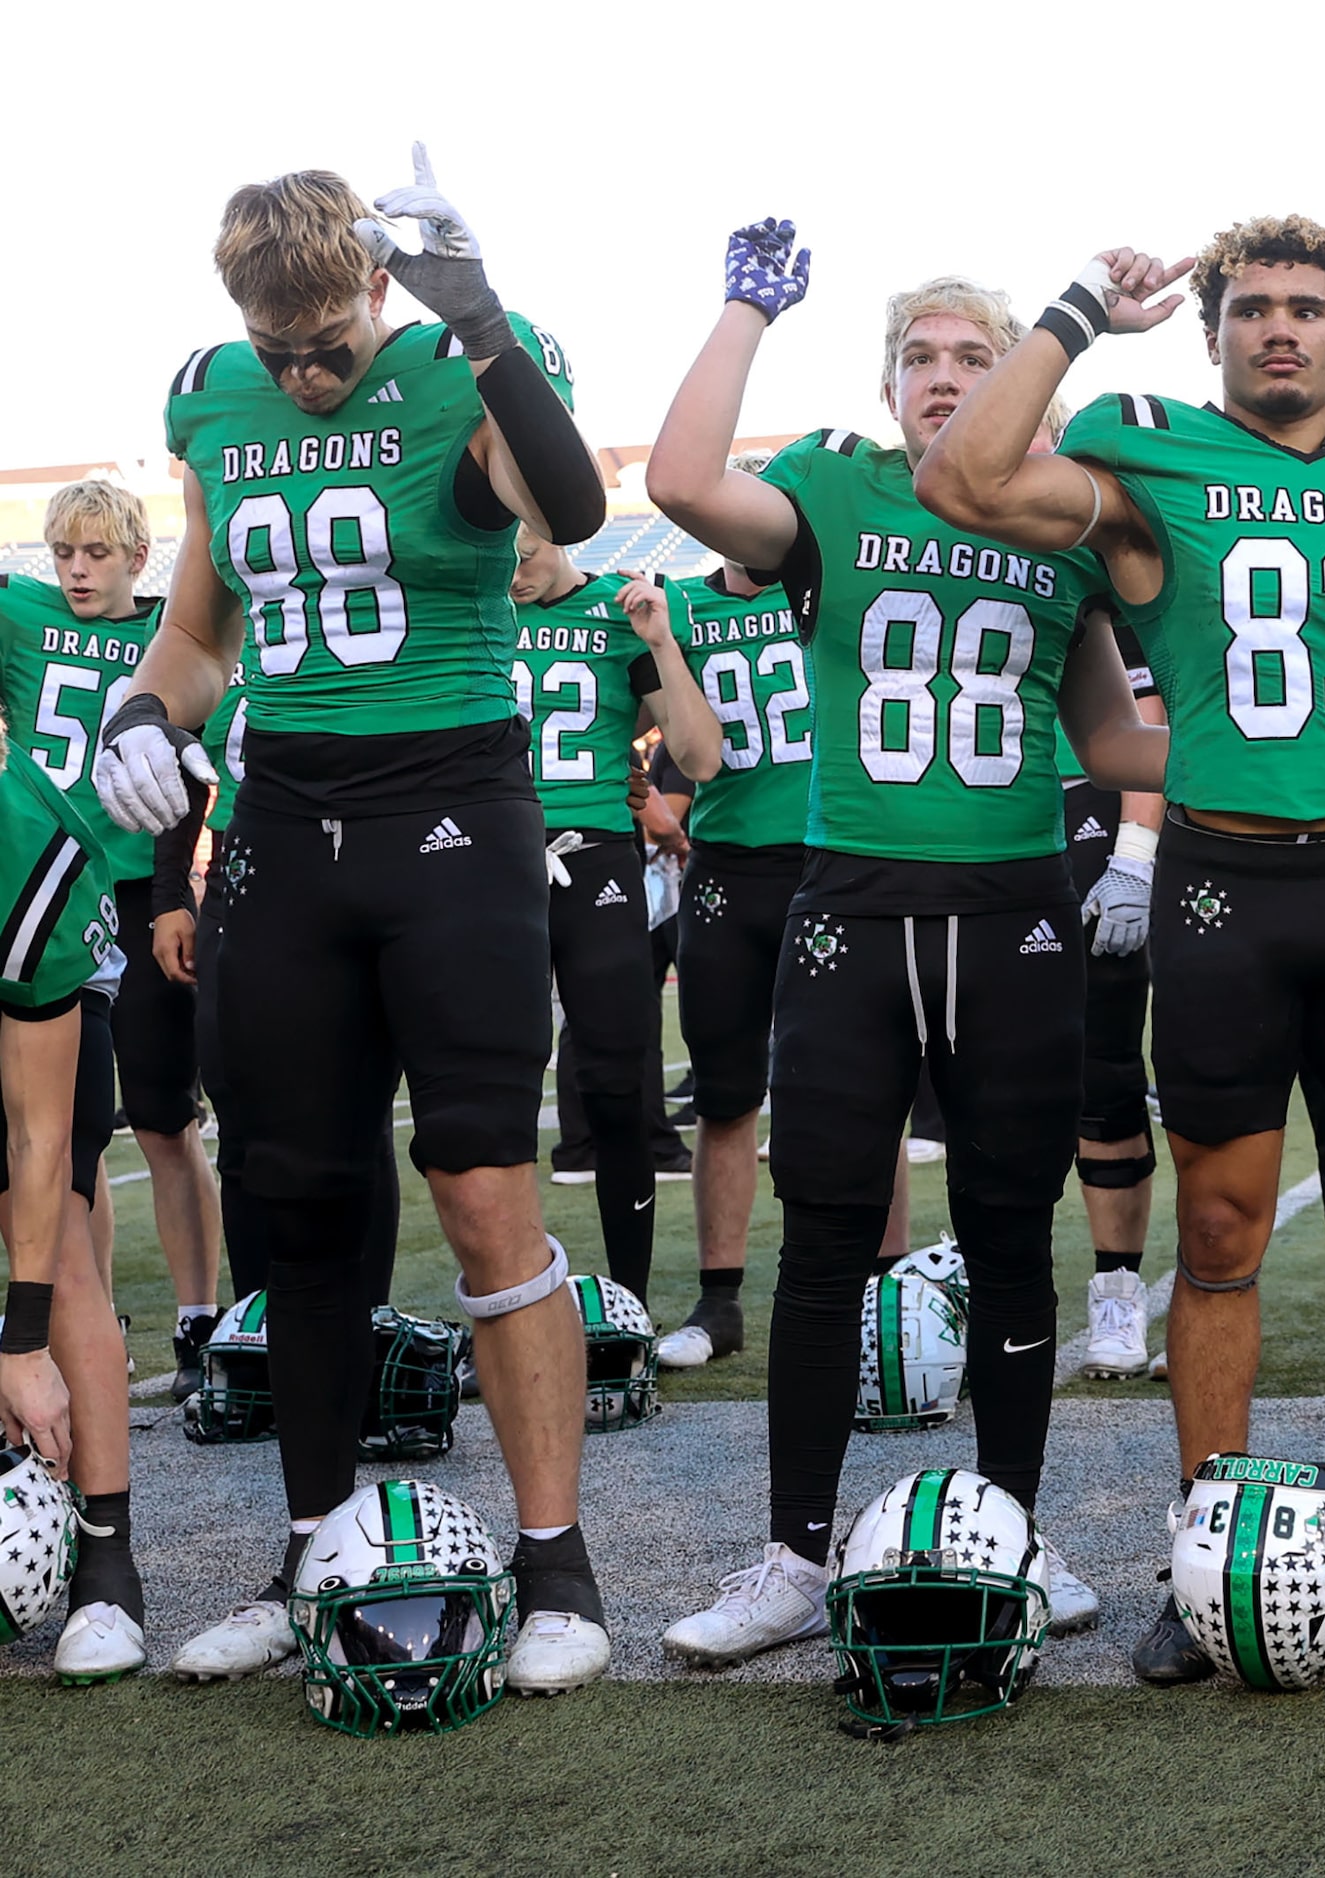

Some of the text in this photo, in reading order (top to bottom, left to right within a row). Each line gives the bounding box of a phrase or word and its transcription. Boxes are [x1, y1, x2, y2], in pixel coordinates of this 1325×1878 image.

[221, 427, 402, 483] DRAGONS
[226, 485, 410, 678] 88
[855, 532, 1057, 598] DRAGONS
[41, 625, 142, 667] DRAGO
[516, 625, 609, 656] AGONS
[690, 609, 799, 648] DRAGON
[701, 640, 814, 771] 92
[857, 587, 1037, 788] 88
[420, 836, 472, 853] adidas
[1073, 827, 1109, 842] adidas
[594, 892, 628, 907] adidas
[82, 892, 119, 967] 28
[1019, 940, 1063, 955] adidas
[229, 1333, 264, 1344] Riddell
[1213, 1457, 1318, 1488] CARROLL
[1208, 1500, 1296, 1540] 8 3
